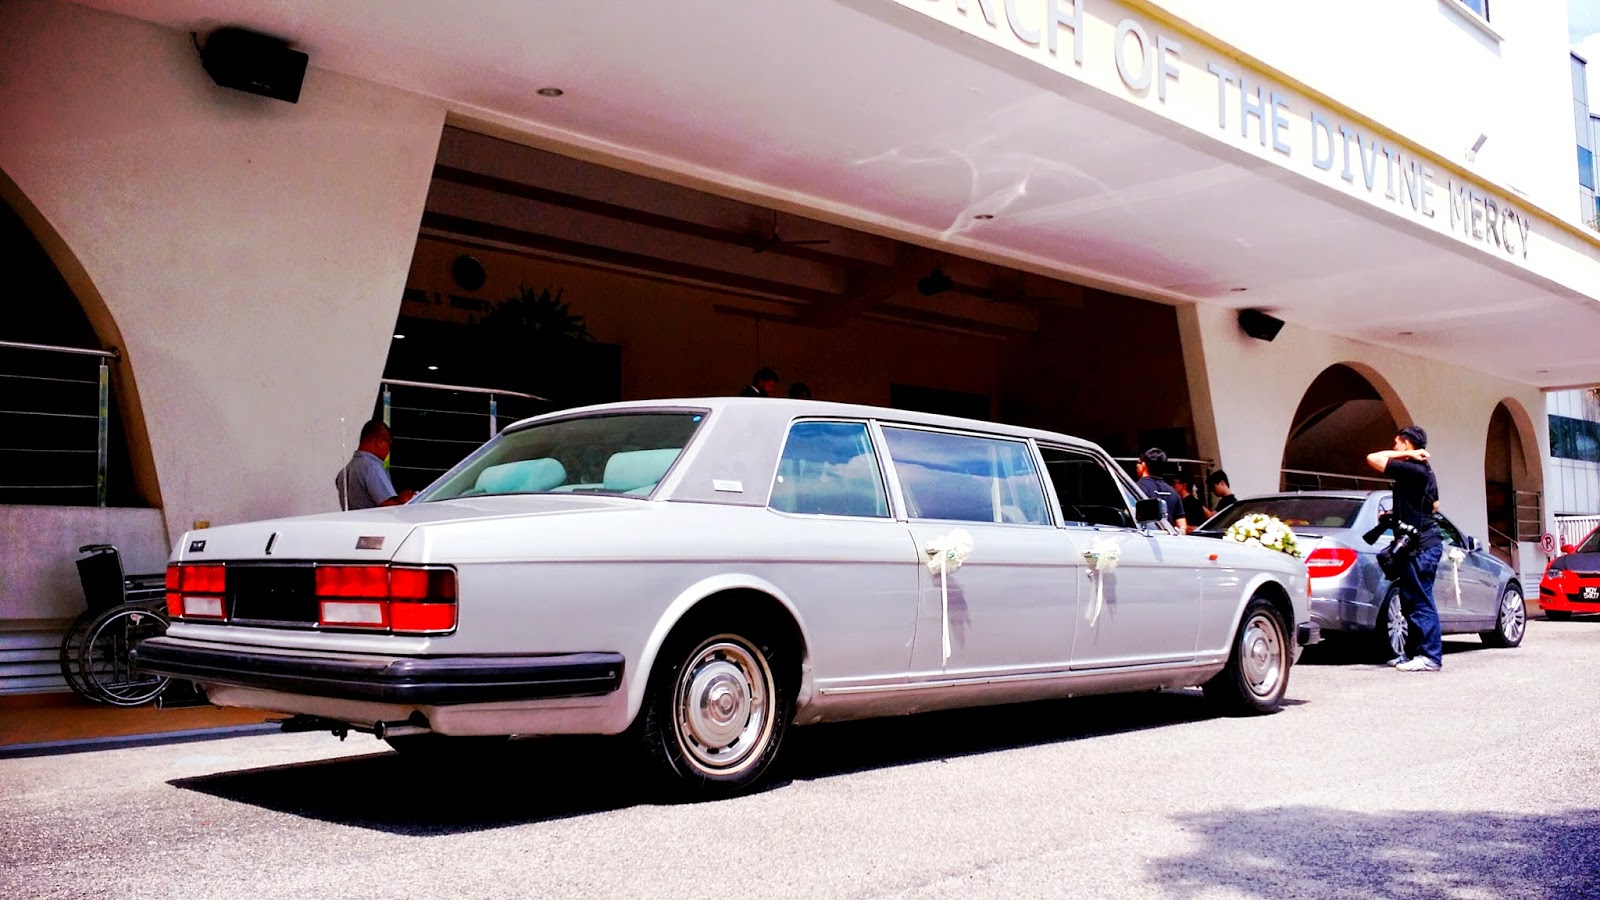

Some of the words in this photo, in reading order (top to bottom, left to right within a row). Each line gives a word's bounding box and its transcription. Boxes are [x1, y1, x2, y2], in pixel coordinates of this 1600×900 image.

[1114, 19, 1181, 104] OF
[1207, 61, 1291, 157] THE
[1311, 111, 1435, 218] DIVINE
[1449, 181, 1531, 260] MERCY
